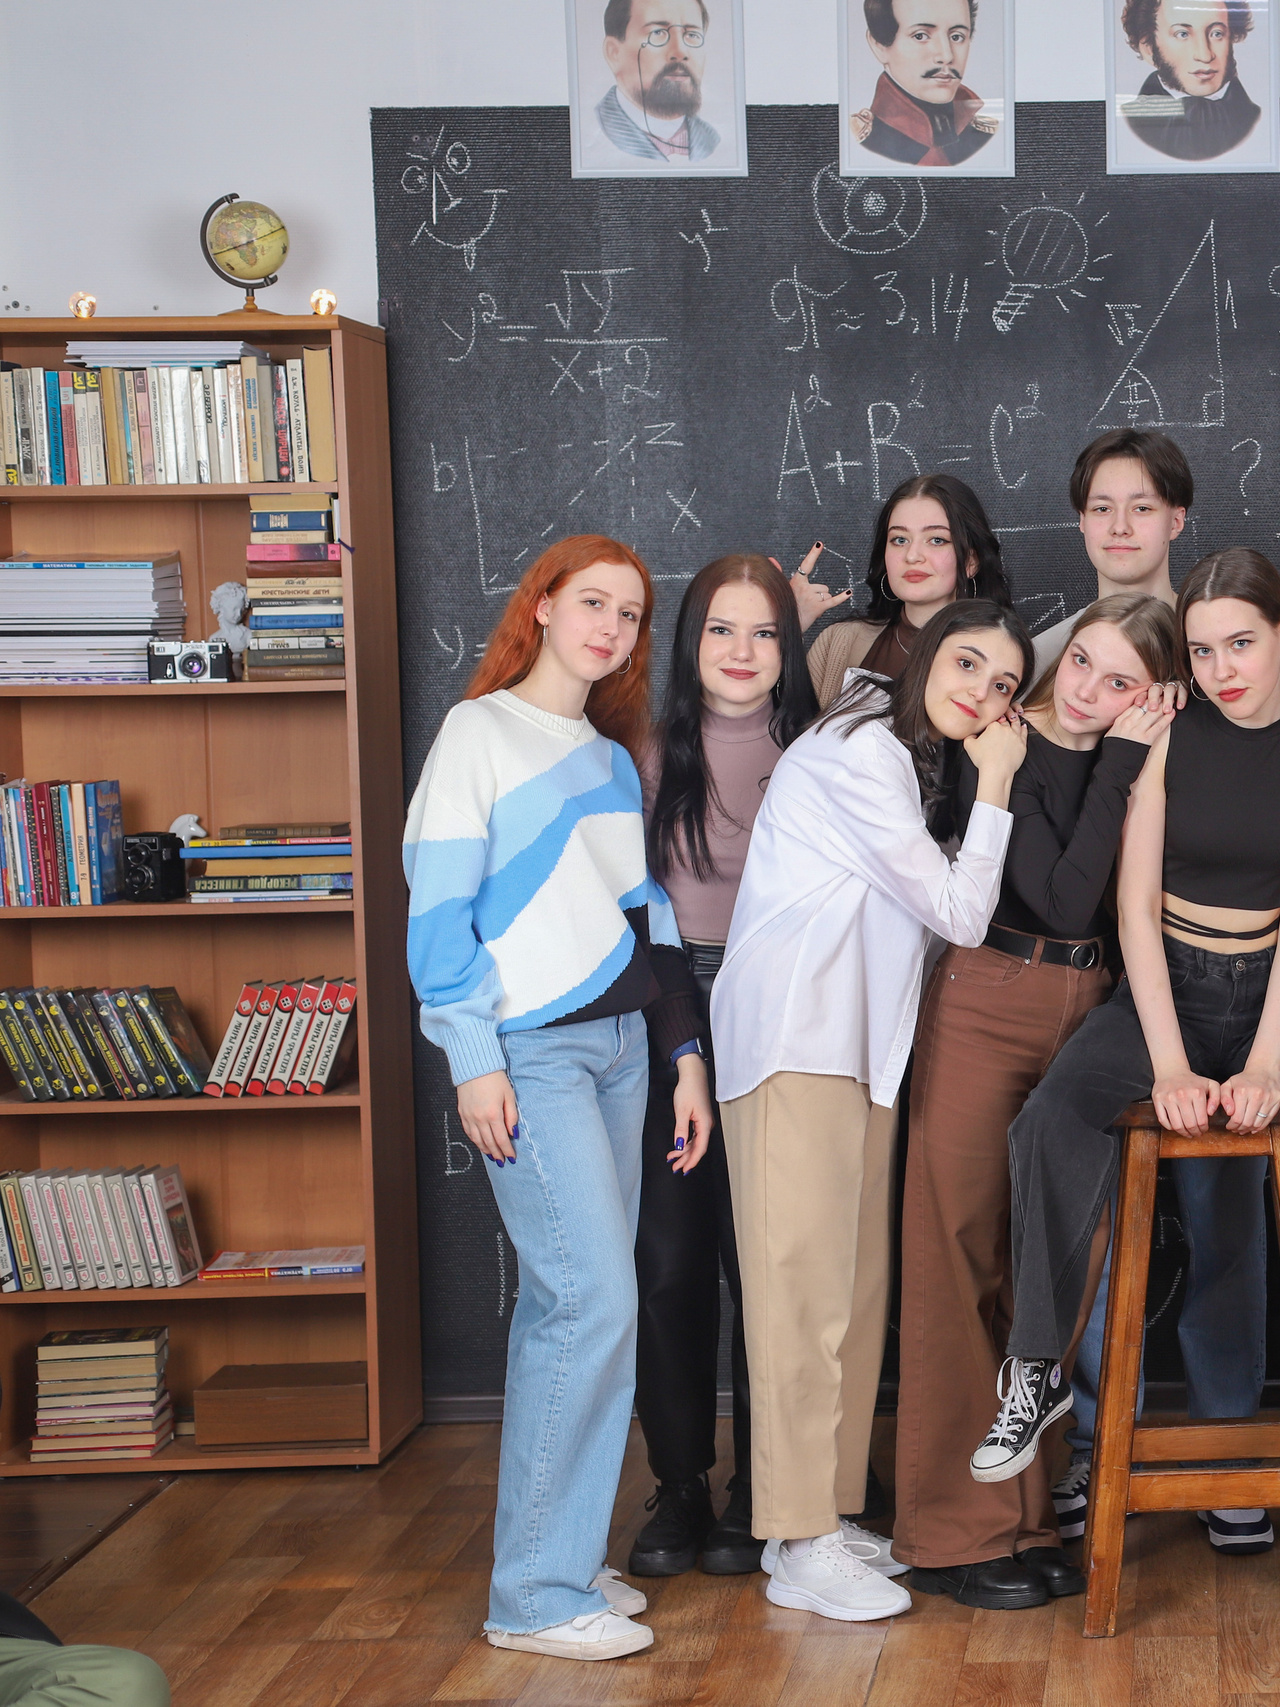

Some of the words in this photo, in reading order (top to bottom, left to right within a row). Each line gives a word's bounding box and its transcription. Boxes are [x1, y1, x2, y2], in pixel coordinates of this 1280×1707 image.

[276, 396, 287, 425] МАСКА
[65, 830, 73, 863] АЛГЕБРА
[77, 834, 86, 865] ГЕОМЕТРИЯ
[195, 878, 244, 890] ГИННЕССА
[247, 877, 299, 889] РЕКОРДОВ
[229, 1020, 242, 1045] МИРЫ
[249, 1020, 262, 1045] МИРЫ
[270, 1017, 283, 1042] МИРЫ
[291, 1017, 304, 1042] МИРЫ
[311, 1019, 324, 1044] МИРЫ
[330, 1019, 342, 1043] МИРЫ
[215, 1045, 234, 1077] ФОСТЕРА
[235, 1045, 253, 1077] ФОСТЕРА
[258, 1041, 275, 1074] ФОСТЕРА
[279, 1041, 296, 1074] ФОСТЕРА
[298, 1044, 316, 1076] ФОСТЕРА
[317, 1043, 334, 1076] ФОСТЕРА
[7, 1189, 19, 1220] ГАРРИСОНА
[25, 1189, 38, 1220] ГАРРИСОНА
[45, 1189, 57, 1220] ГАРРИСОНА
[59, 1189, 72, 1219] ГАРРИСОНА
[79, 1190, 91, 1220] ГАРРИСОНА
[97, 1189, 108, 1218] ГАРРИСОНА
[116, 1189, 127, 1219] ГАРРИСОНА
[134, 1189, 146, 1219] ГАРРИСОНА
[147, 1189, 158, 1220] ГАРРИСОНА
[13, 1223, 24, 1241] ГАРРИ
[32, 1223, 42, 1241] ГАРРИ
[51, 1222, 61, 1240] ГАРРИ
[67, 1221, 77, 1240] ГАРРИ
[86, 1223, 96, 1240] ГАРРИ
[103, 1221, 114, 1238] ГАРРИ
[122, 1222, 132, 1239] ГАРРИ
[141, 1221, 152, 1239] ГАРРИ
[154, 1222, 164, 1240] ГАРРИ
[18, 1243, 28, 1262] МИРЫ
[38, 1243, 48, 1261] МИРЫ
[57, 1243, 68, 1261] МИРЫ
[72, 1242, 82, 1260] МИРЫ
[91, 1243, 101, 1261] МИРЫ
[108, 1242, 118, 1258] МИРЫ
[127, 1242, 137, 1260] МИРЫ
[147, 1242, 157, 1260] МИРЫ
[159, 1243, 169, 1261] МИРЫ
